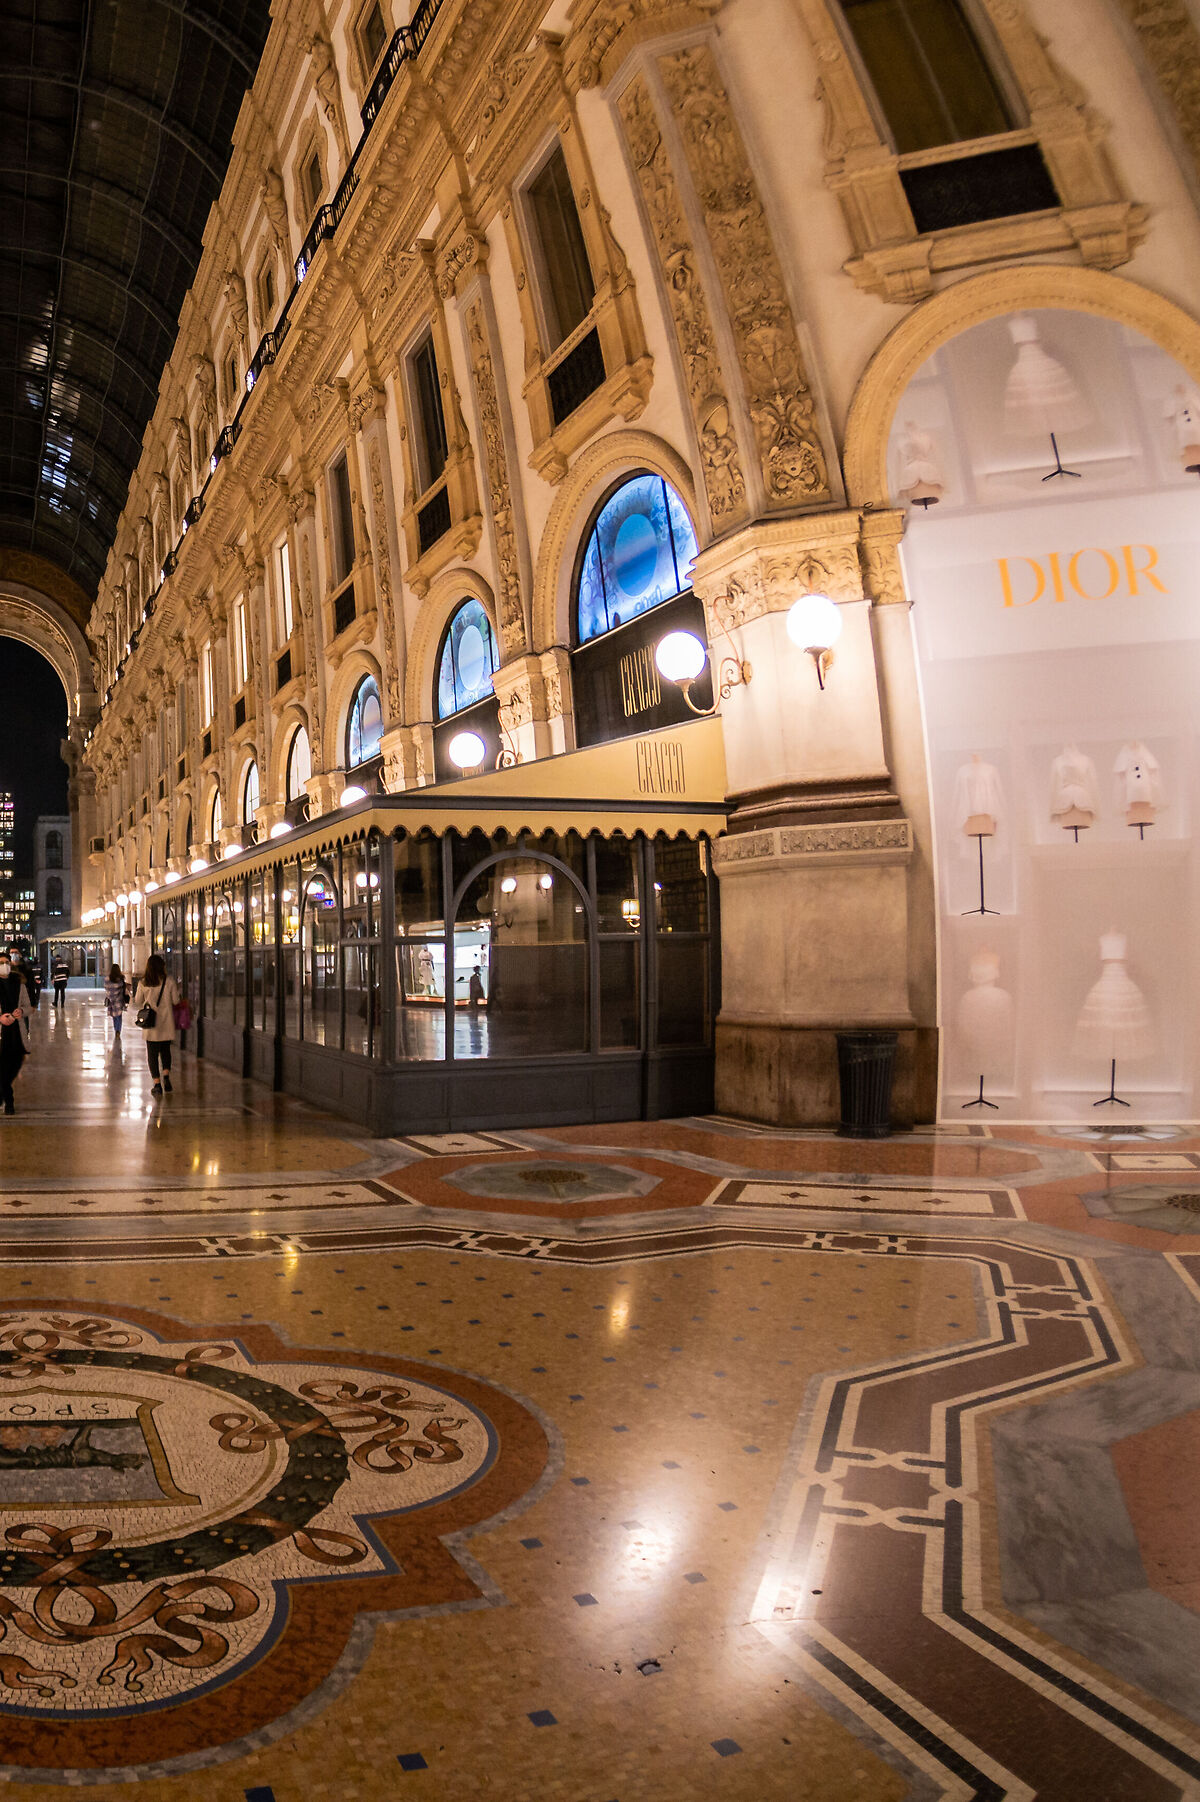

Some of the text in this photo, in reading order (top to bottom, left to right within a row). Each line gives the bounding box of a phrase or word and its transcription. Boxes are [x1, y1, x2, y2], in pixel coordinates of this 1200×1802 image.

[993, 543, 1172, 609] DIOR
[620, 642, 661, 718] CRACCO
[636, 740, 686, 794] CRACCO
